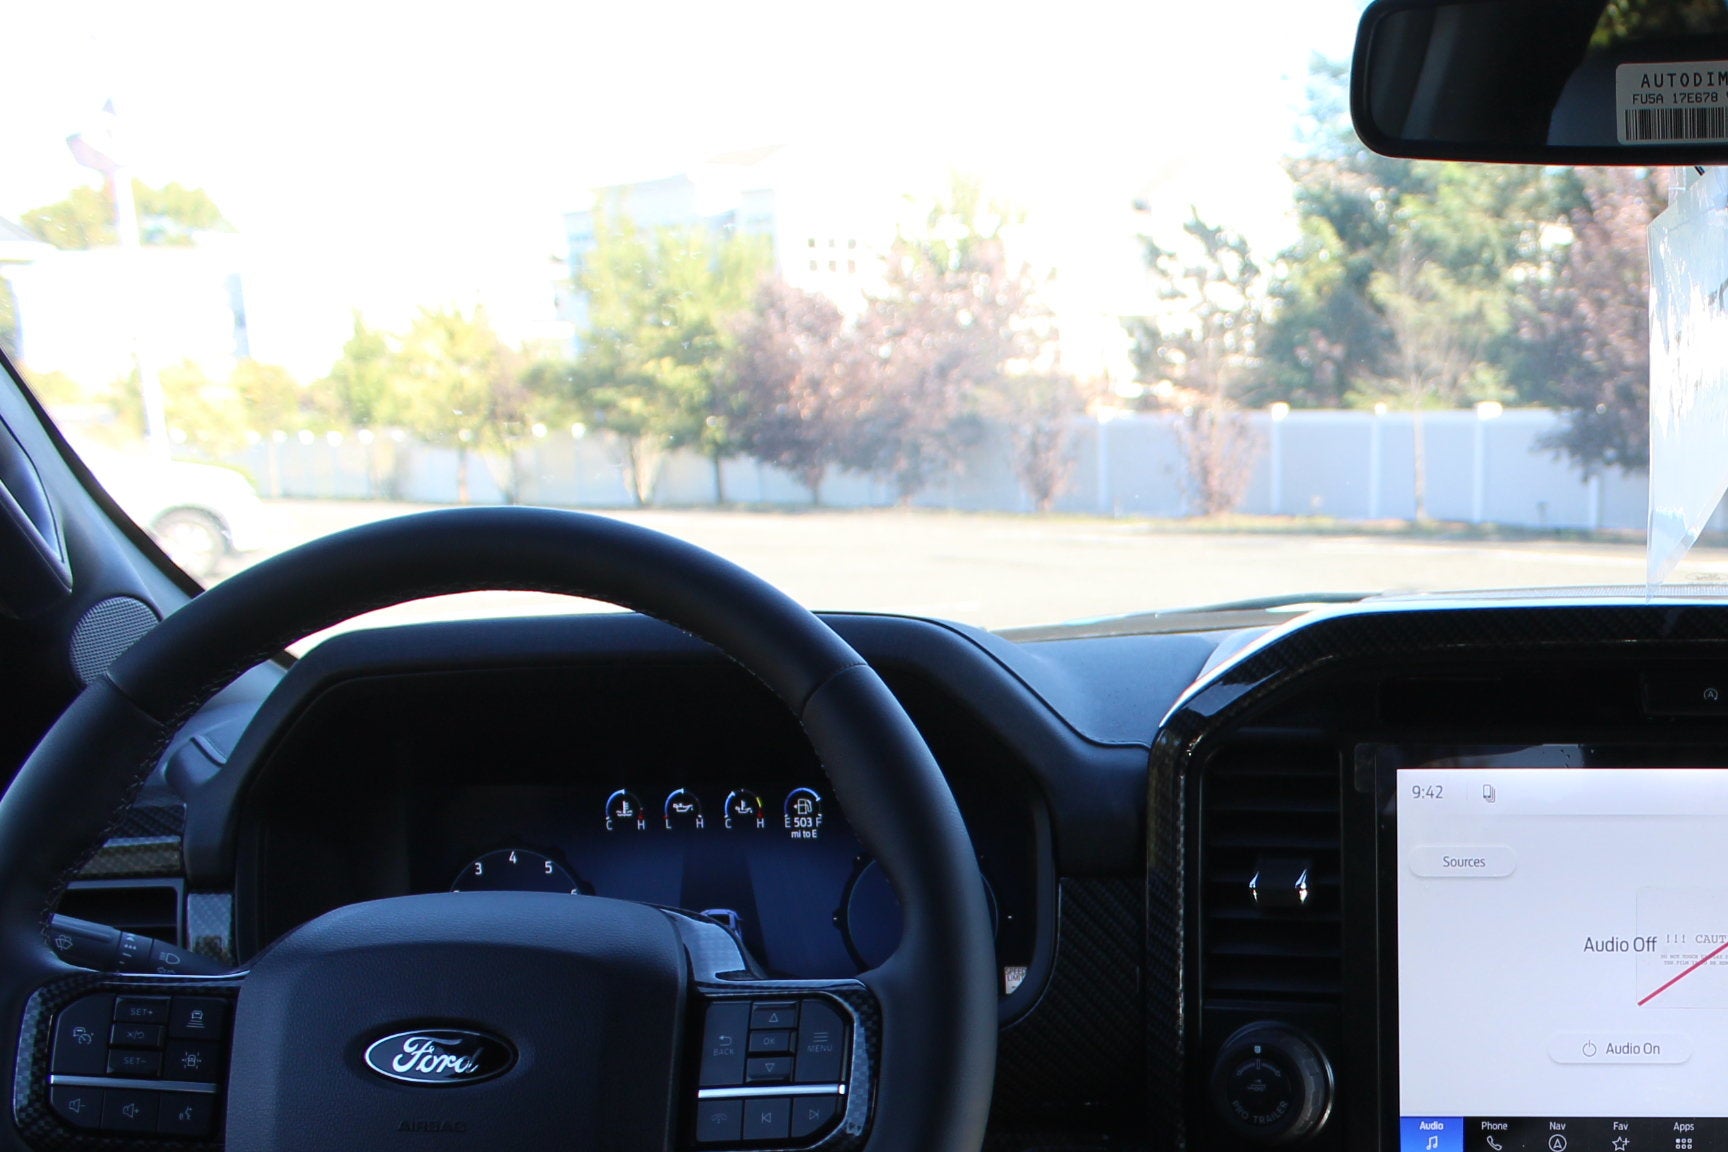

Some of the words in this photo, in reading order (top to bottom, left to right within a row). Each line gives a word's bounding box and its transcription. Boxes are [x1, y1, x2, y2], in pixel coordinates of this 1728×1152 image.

[1641, 71, 1728, 88] AUTODIM
[1673, 92, 1718, 104] 17E678
[1412, 785, 1444, 799] 9:42
[606, 821, 613, 831] C
[638, 820, 646, 830] H
[665, 819, 672, 829] L
[696, 819, 704, 829] H
[725, 819, 732, 829] C
[757, 818, 765, 829] H
[785, 818, 791, 828] E
[794, 817, 813, 828] 503
[815, 818, 822, 828] F
[791, 829, 802, 839] mi
[802, 830, 811, 839] to
[811, 830, 817, 838] E
[508, 850, 517, 864] 4
[1443, 856, 1486, 868] Sources
[474, 862, 483, 876] 3
[544, 860, 553, 874] 5
[1583, 936, 1629, 952] Audio
[1633, 936, 1658, 952] Off
[130, 1008, 154, 1016] SET+
[763, 1037, 776, 1045] OK
[713, 1048, 734, 1056] BACK
[807, 1044, 833, 1053] MENU
[1605, 1042, 1641, 1055] Audio
[1643, 1042, 1660, 1055] On
[392, 1036, 484, 1073] Ford
[1231, 1099, 1249, 1120] PRO
[1252, 1100, 1289, 1124] TRAILER
[397, 1119, 467, 1133] AIRBAG
[1419, 1121, 1444, 1131] Audio
[1481, 1121, 1508, 1131] Phone
[1549, 1122, 1566, 1131] Nav
[1613, 1122, 1629, 1131] Fav
[1673, 1122, 1695, 1132] Apps
